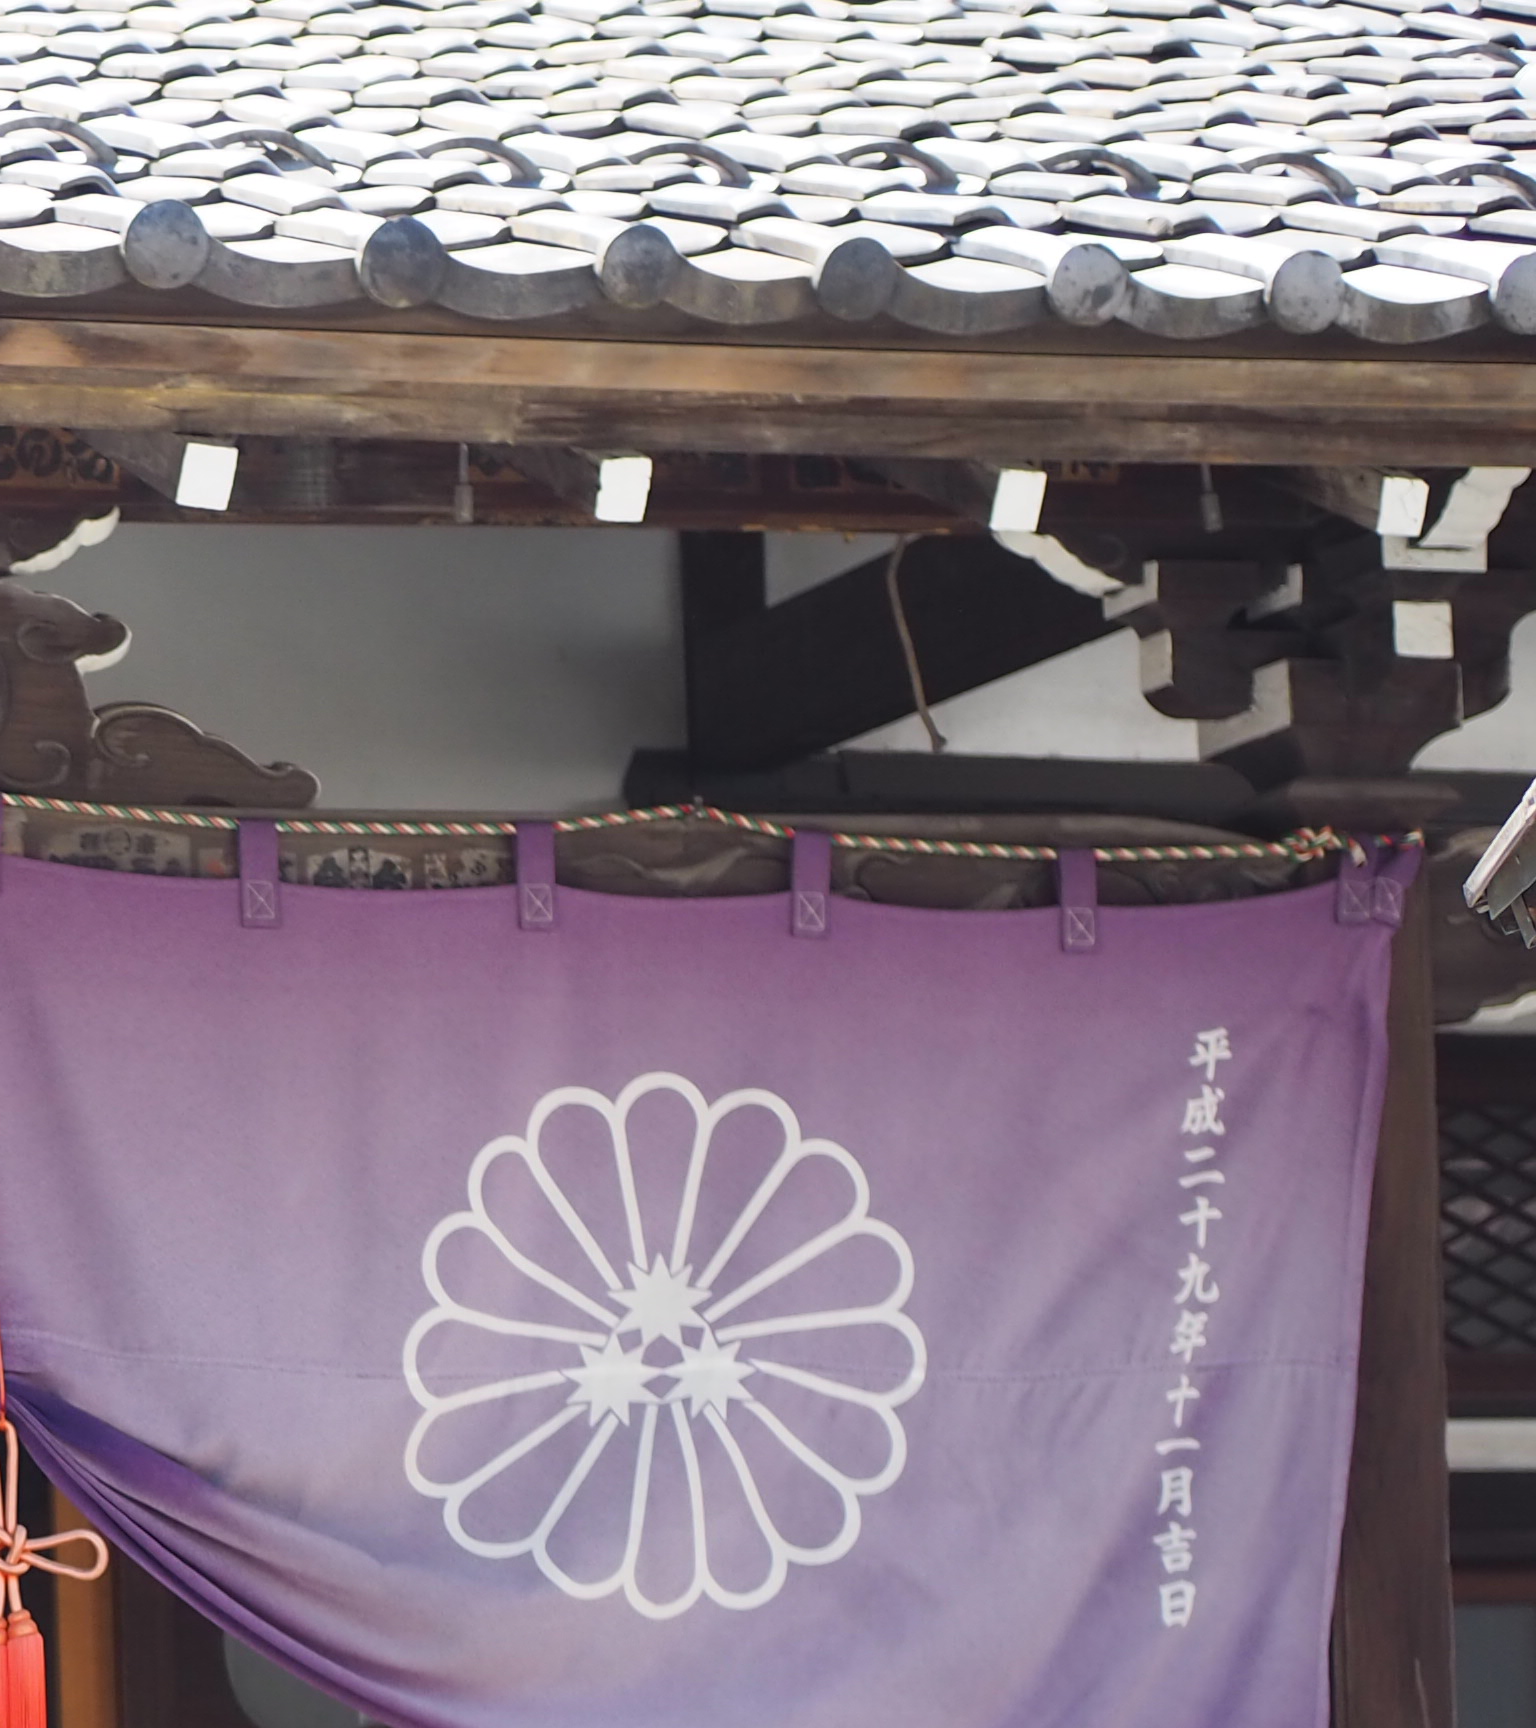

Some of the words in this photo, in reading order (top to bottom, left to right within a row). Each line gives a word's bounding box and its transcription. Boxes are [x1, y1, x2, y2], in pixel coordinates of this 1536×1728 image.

[1152, 1026, 1233, 1630] 平成二十九年十一月吉日
